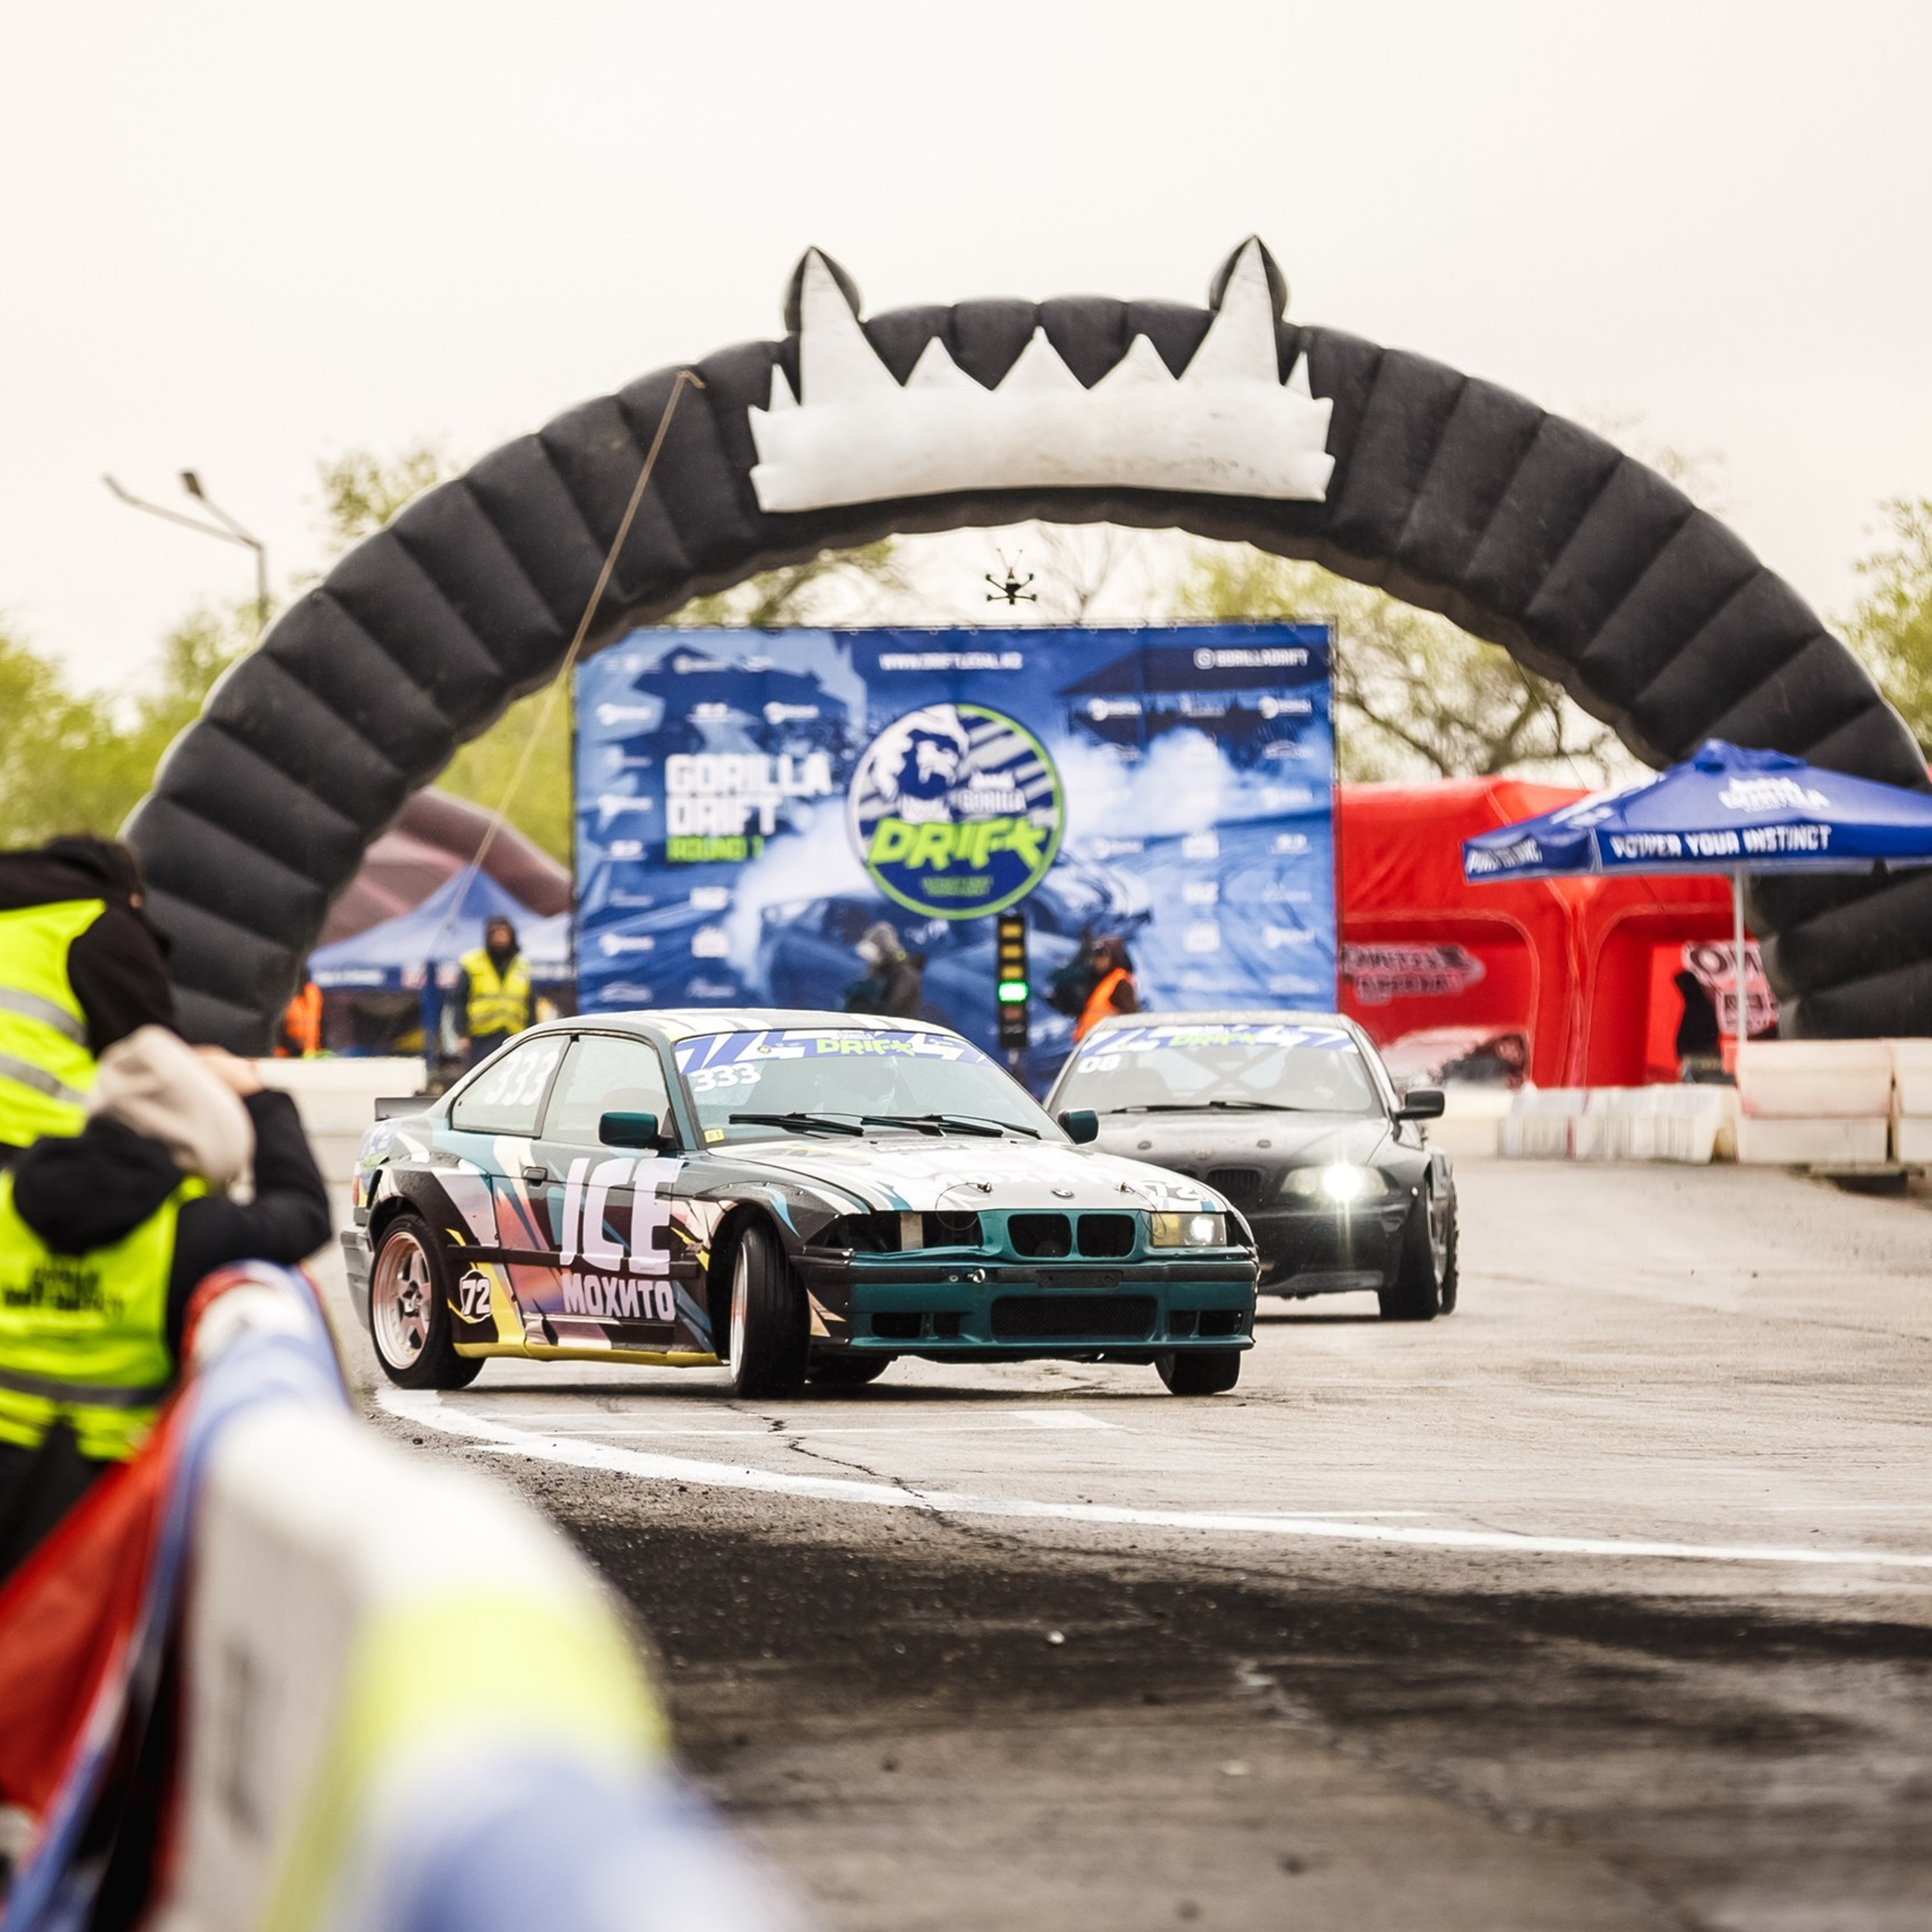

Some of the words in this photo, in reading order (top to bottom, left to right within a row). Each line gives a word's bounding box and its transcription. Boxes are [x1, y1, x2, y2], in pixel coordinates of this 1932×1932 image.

[666, 753, 832, 795] GORILLA
[666, 795, 783, 835] DRIFT
[870, 817, 1046, 870] DRIFT
[1684, 831, 1740, 857] YOUR
[1742, 824, 1832, 853] INSTINCT
[817, 1038, 915, 1057] DRIFT
[484, 1050, 560, 1106] 333
[690, 1063, 761, 1092] 333
[559, 1158, 686, 1275] ICE
[461, 1278, 492, 1316] 72
[561, 1273, 676, 1321] МОХИТО
